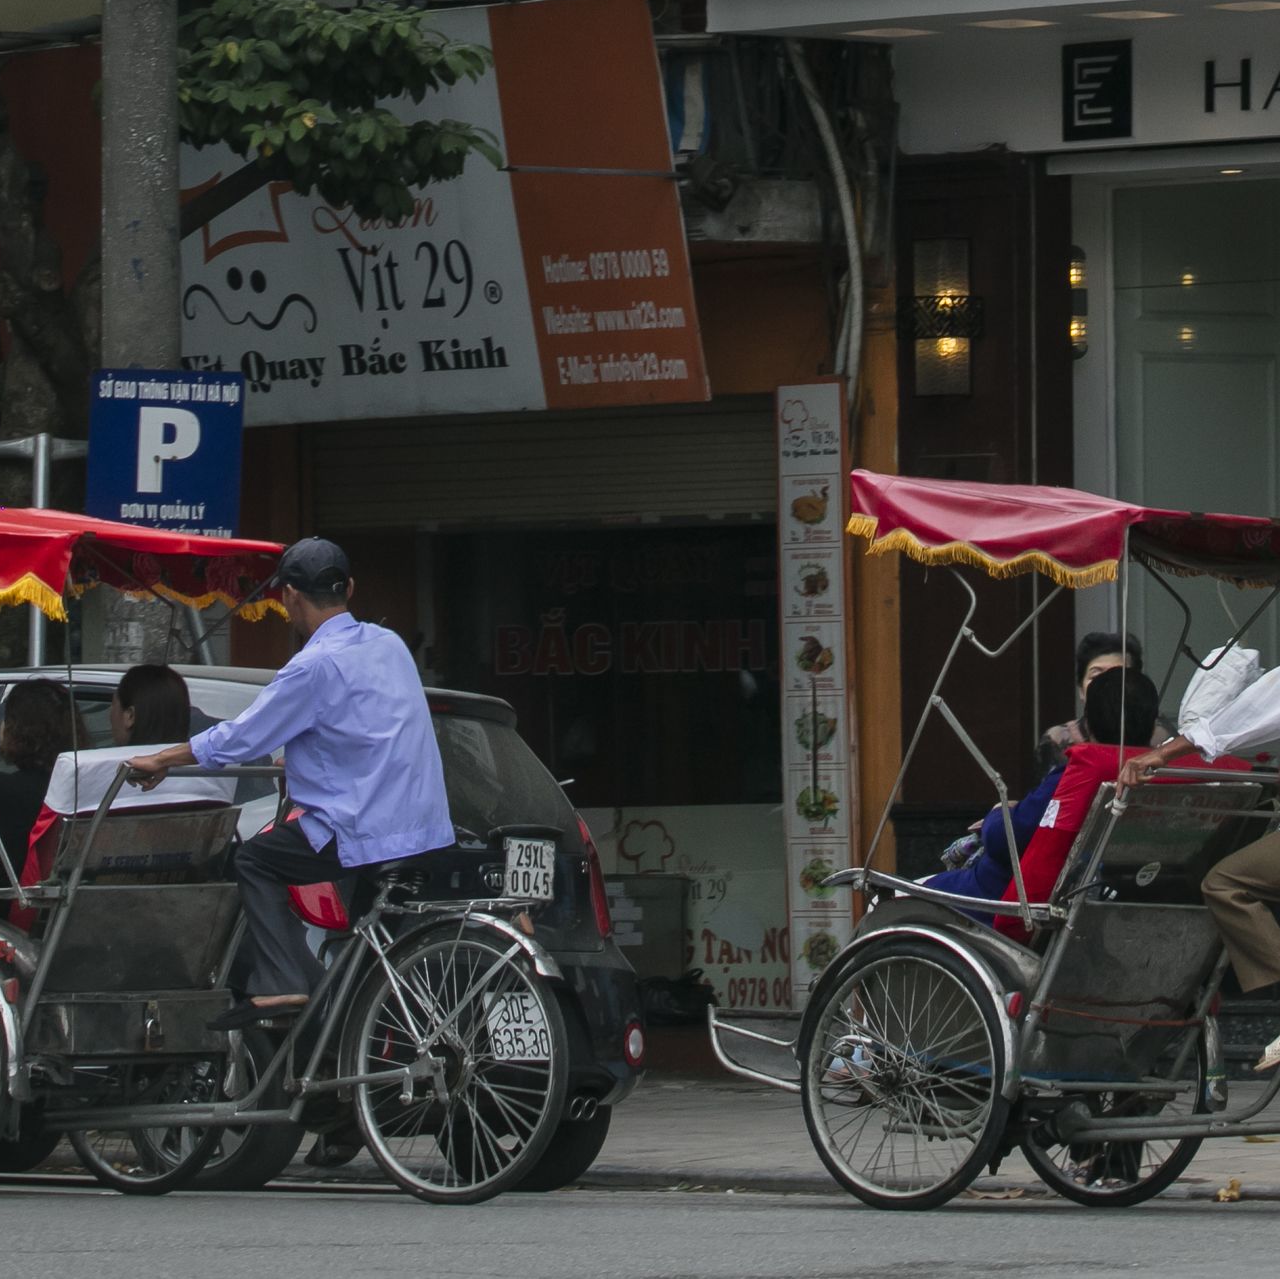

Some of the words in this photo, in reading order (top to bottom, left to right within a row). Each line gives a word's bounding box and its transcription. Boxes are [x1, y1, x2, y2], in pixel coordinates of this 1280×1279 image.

[336, 246, 406, 330] Vịt
[414, 238, 475, 319] 29
[240, 349, 326, 394] Quay
[337, 336, 408, 378] Bắc
[418, 336, 509, 373] Kinh
[136, 406, 201, 493] P
[191, 503, 206, 520] LÝ
[494, 606, 613, 676] BẮC
[621, 619, 769, 673] KINH
[516, 843, 547, 869] 29XL
[707, 878, 728, 903] 29
[728, 976, 769, 1009] 0978
